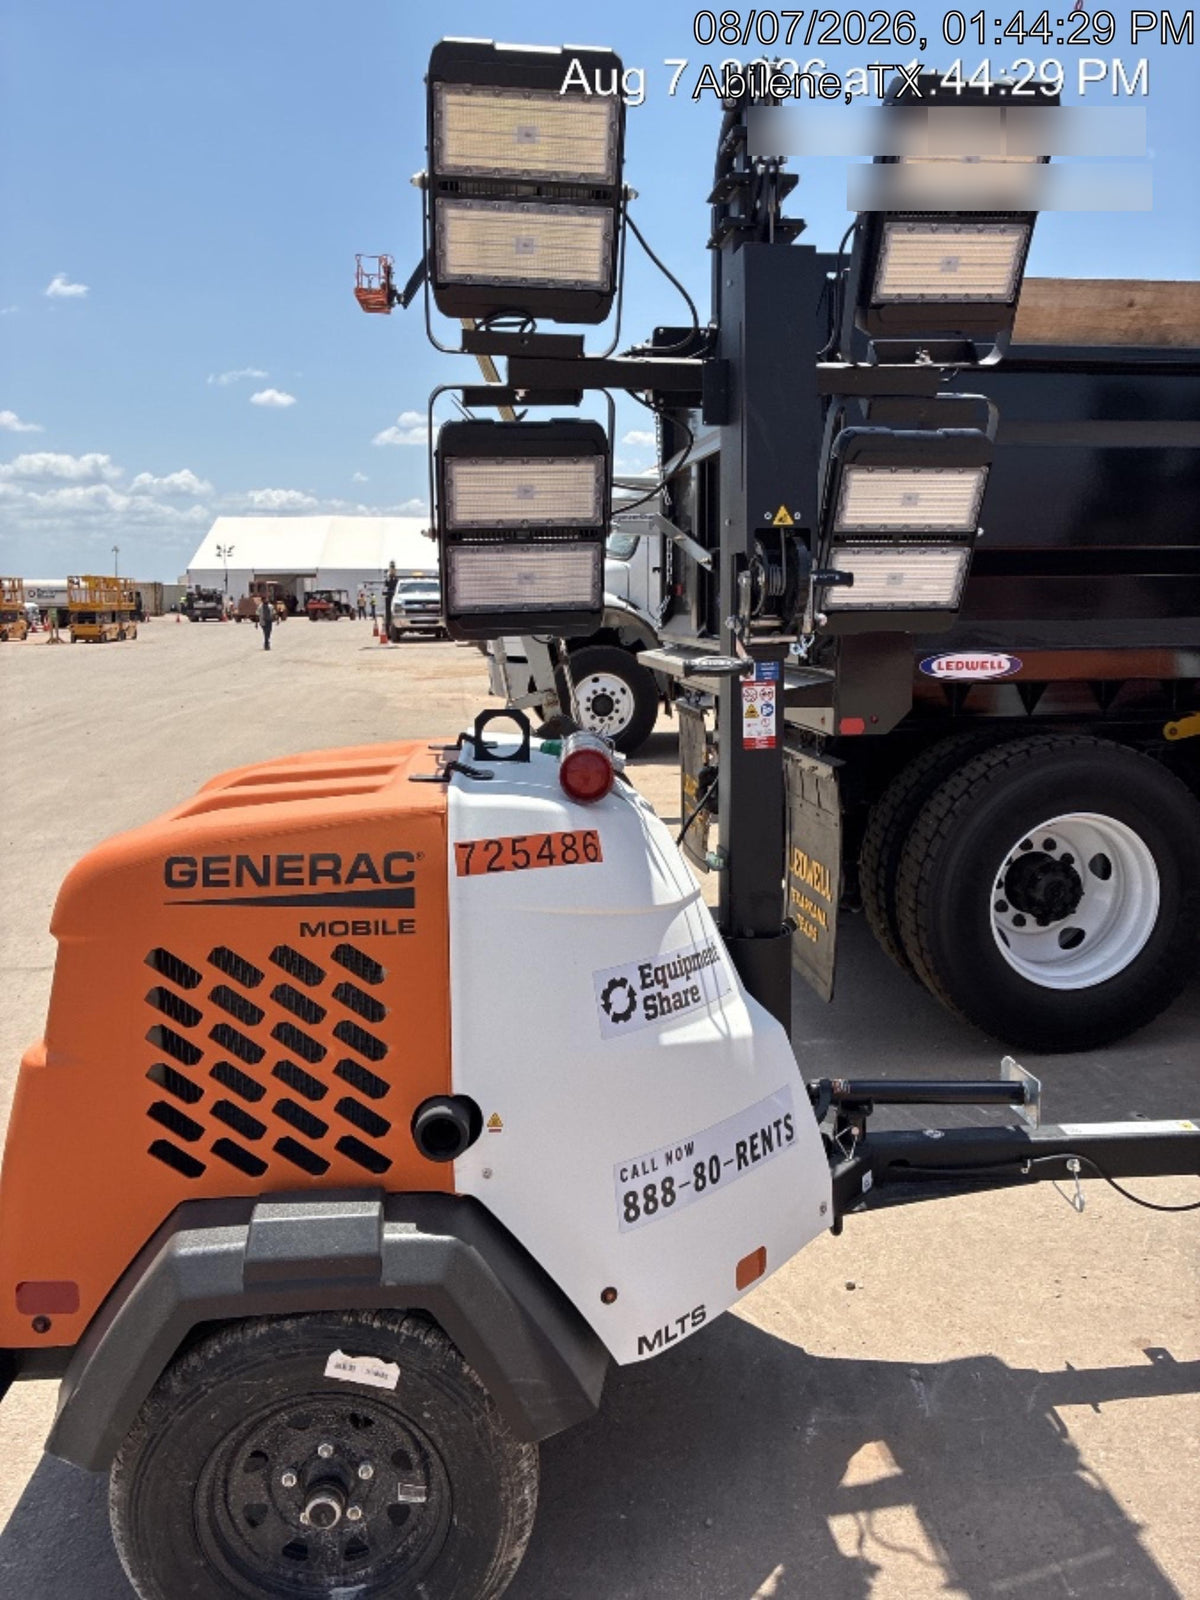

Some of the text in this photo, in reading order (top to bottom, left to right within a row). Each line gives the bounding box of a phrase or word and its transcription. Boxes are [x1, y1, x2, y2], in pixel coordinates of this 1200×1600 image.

[937, 660, 1005, 671] LEDWELL
[458, 831, 599, 875] 725486
[300, 919, 416, 938] MOBILE
[638, 942, 720, 991] Equipment
[642, 984, 701, 1021] Share
[619, 1141, 694, 1182] CALL NOW
[623, 1113, 794, 1223] 888-80-RENTS
[637, 1304, 706, 1355] MLTS
